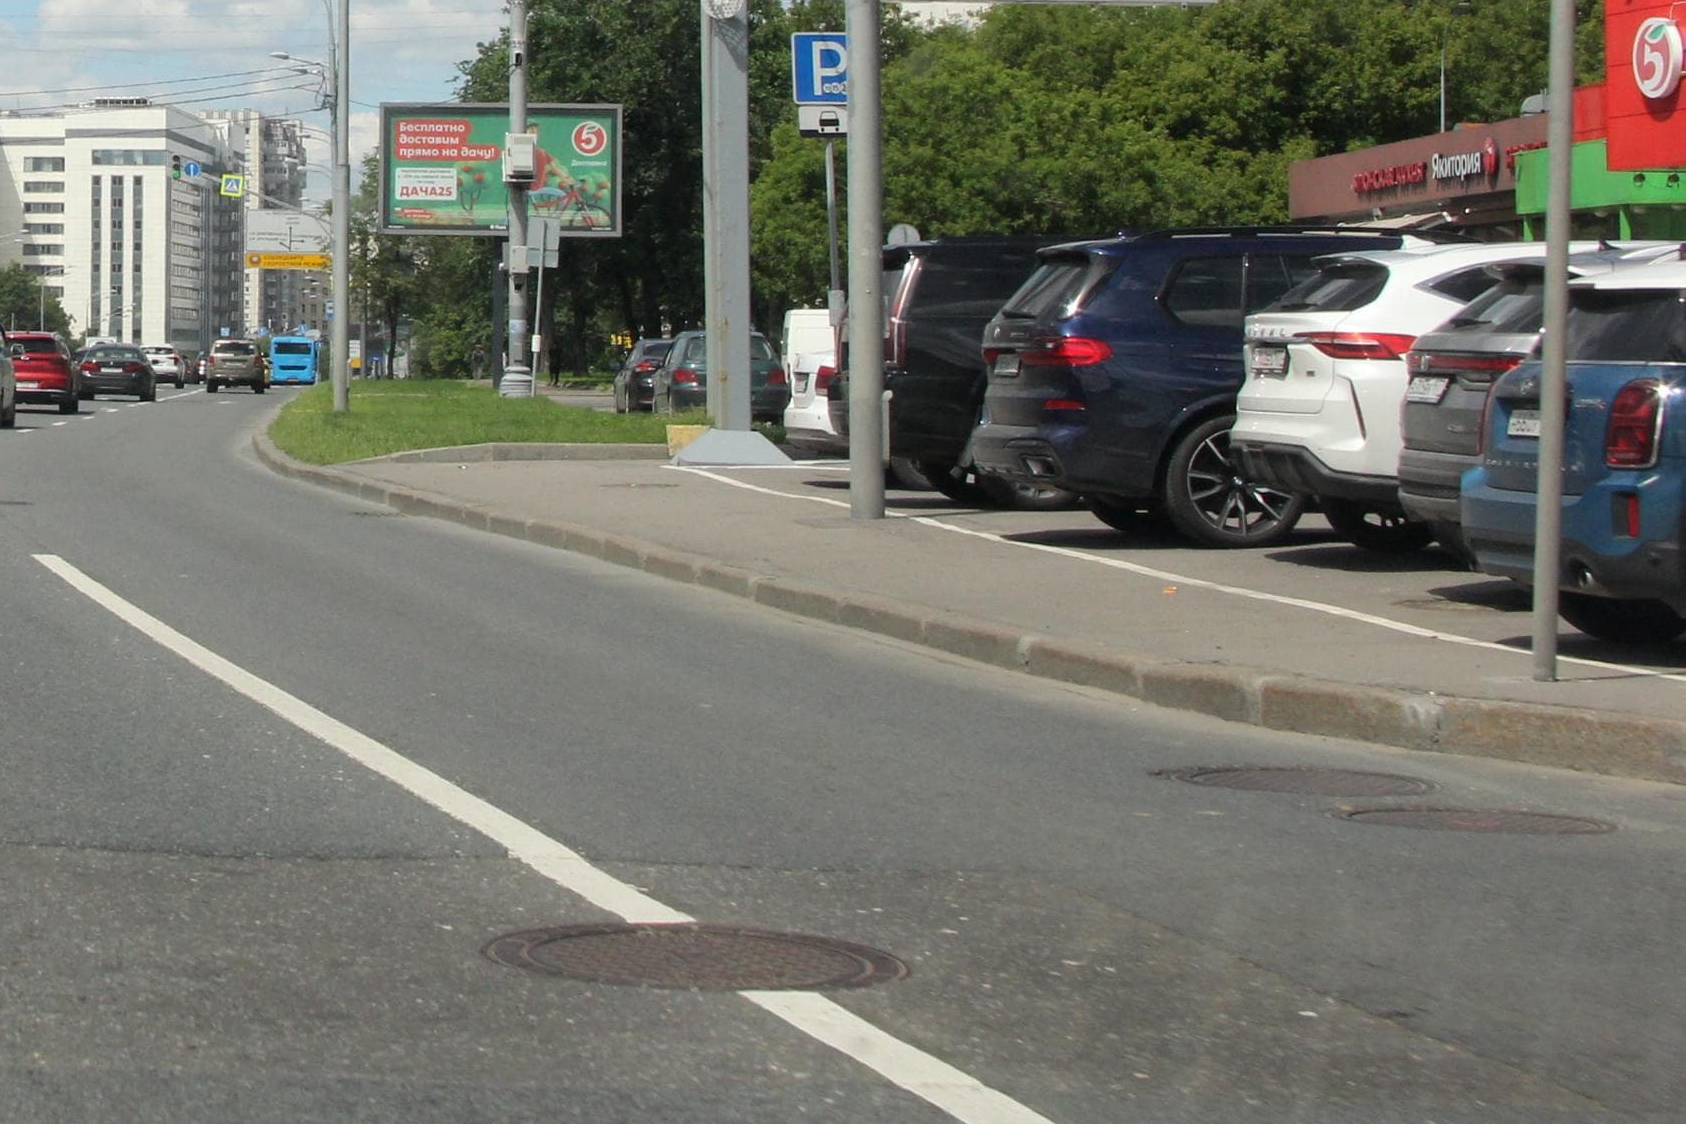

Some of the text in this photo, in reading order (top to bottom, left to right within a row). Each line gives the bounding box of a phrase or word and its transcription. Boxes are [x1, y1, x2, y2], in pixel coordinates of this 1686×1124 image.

[812, 41, 848, 96] P
[399, 122, 465, 132] Бесплатно
[399, 134, 459, 144] доставим
[399, 146, 495, 159] прямо на дачу!
[1432, 152, 1481, 181] Якитория
[400, 186, 452, 197] ДАЧА25
